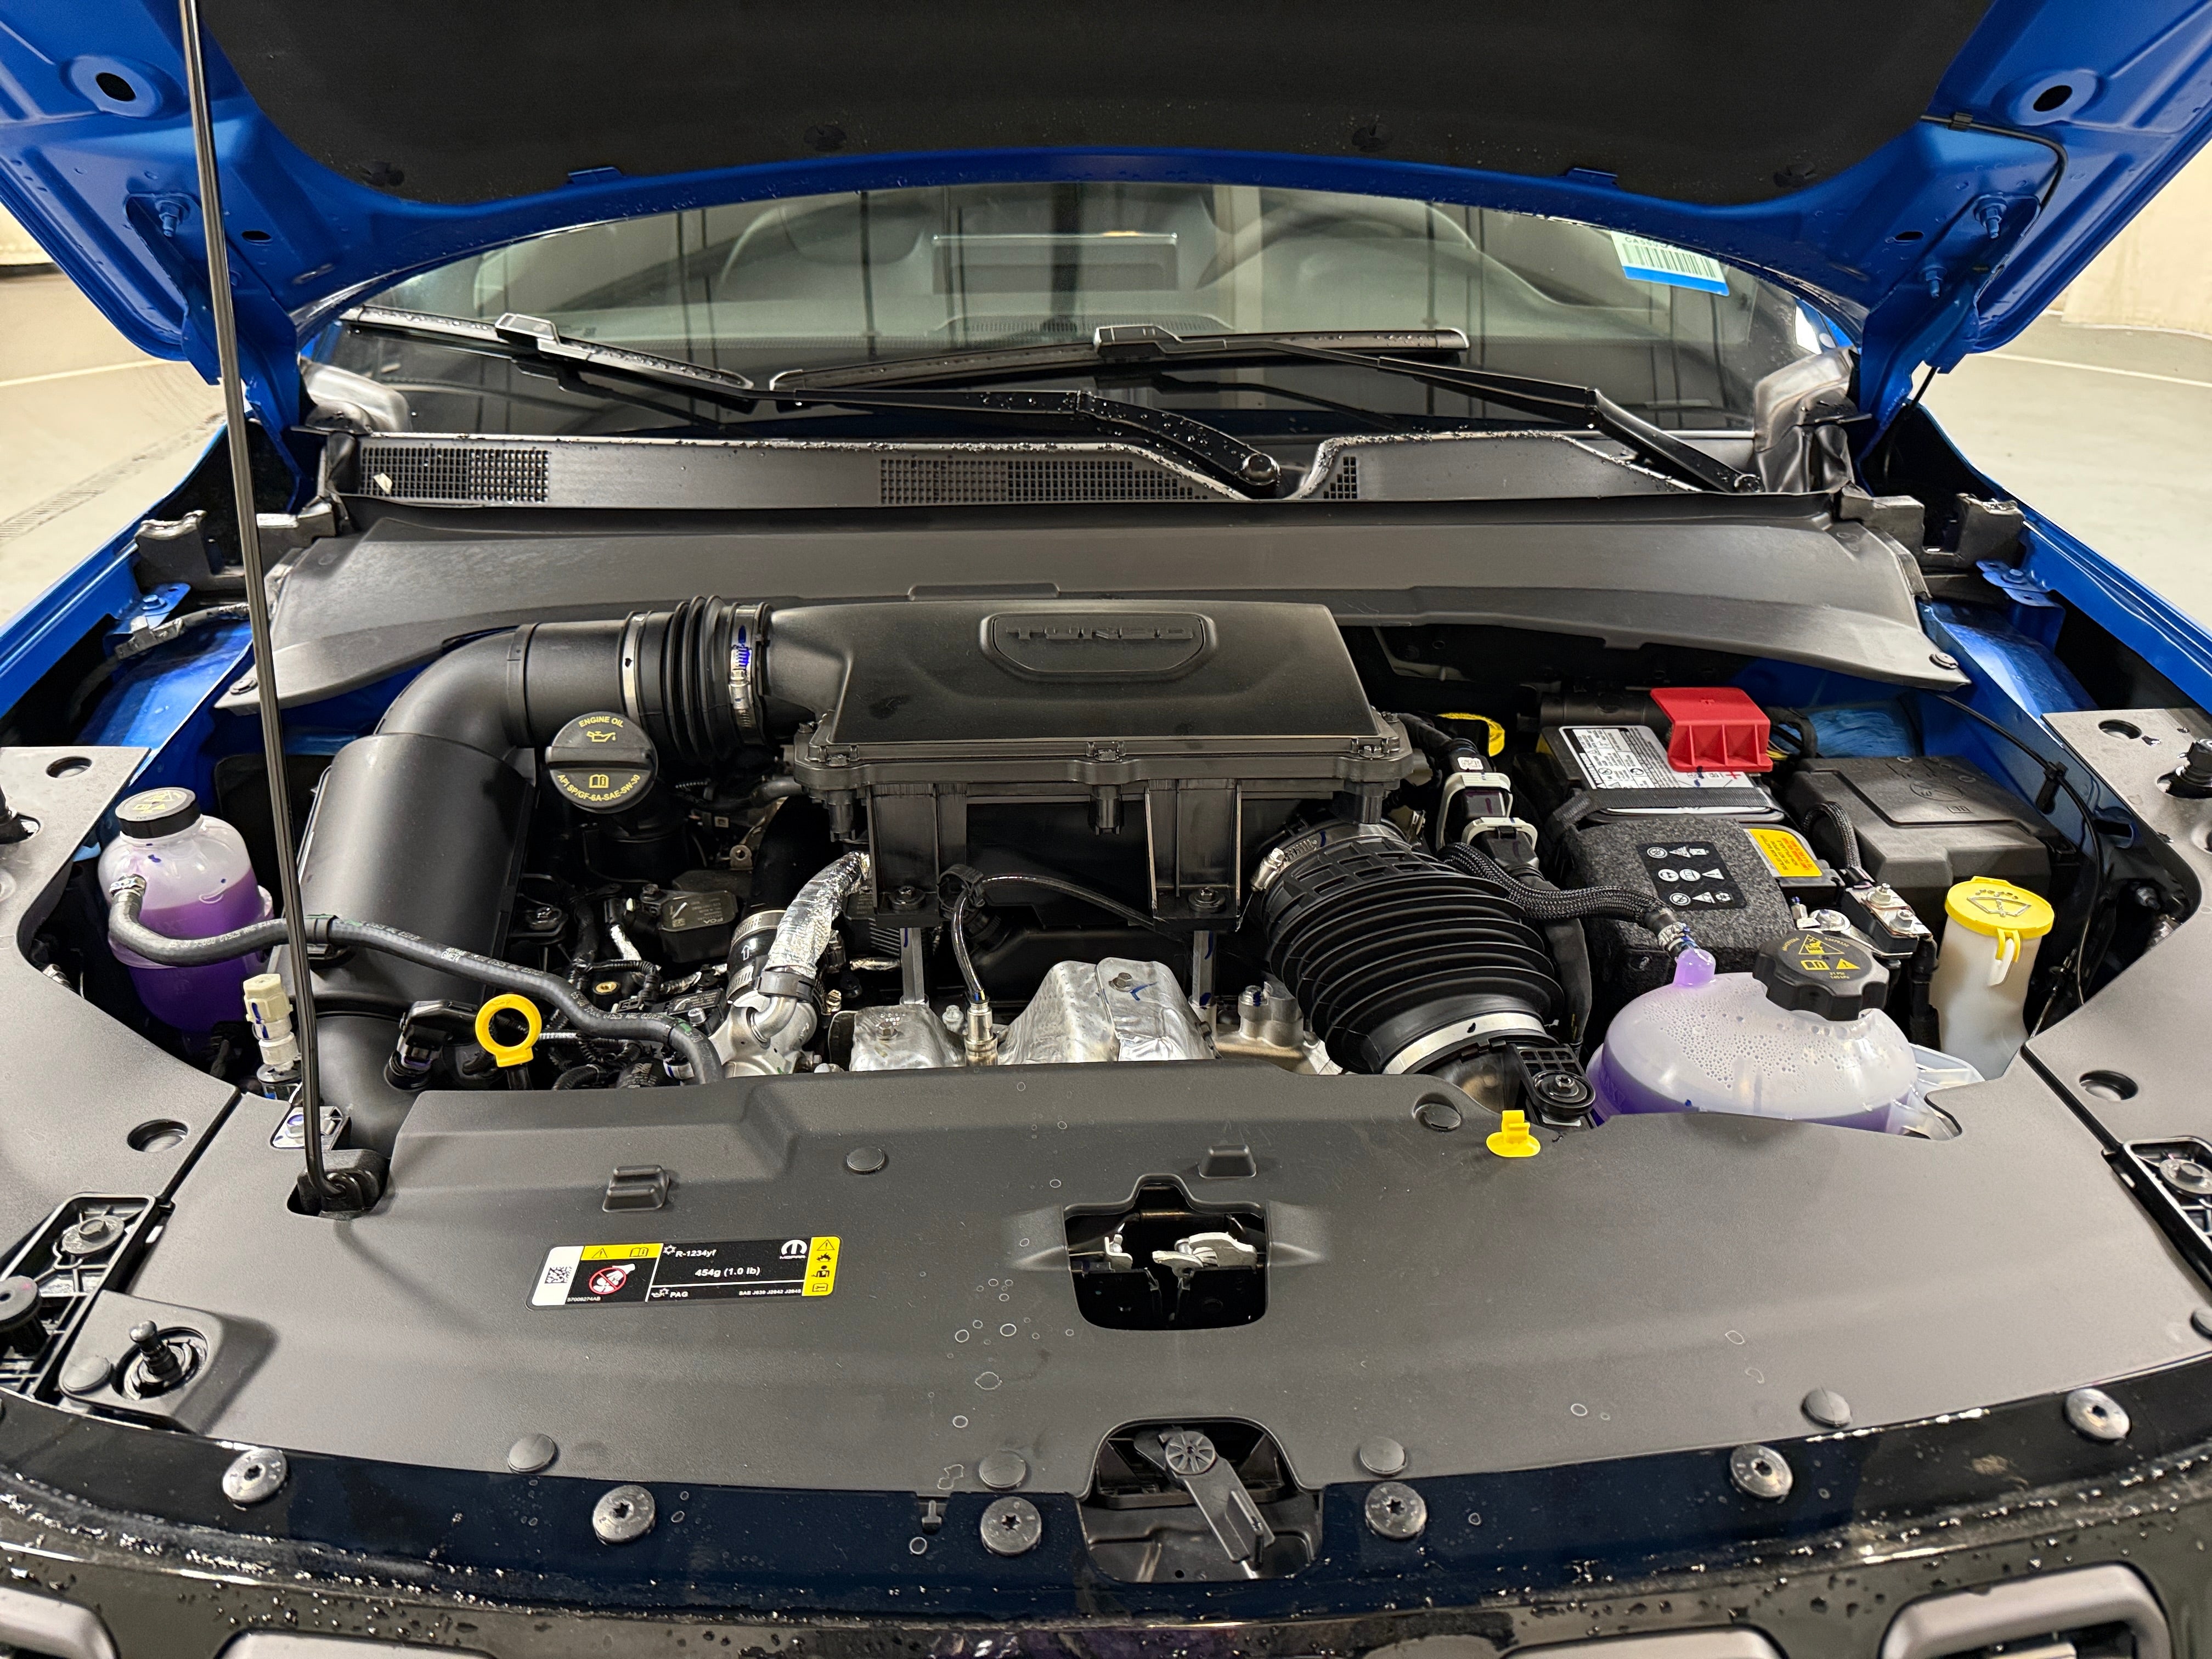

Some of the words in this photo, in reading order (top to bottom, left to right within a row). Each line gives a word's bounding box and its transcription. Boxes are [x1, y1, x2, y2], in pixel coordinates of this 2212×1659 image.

[1005, 627, 1193, 640] TURBO
[578, 716, 610, 727] ENGINE
[611, 718, 624, 727] OIL
[557, 774, 569, 787] API
[675, 1249, 716, 1257] R-1234yf
[695, 1269, 721, 1277] 454g
[724, 1267, 743, 1277] (1.0
[746, 1267, 760, 1276] lb)
